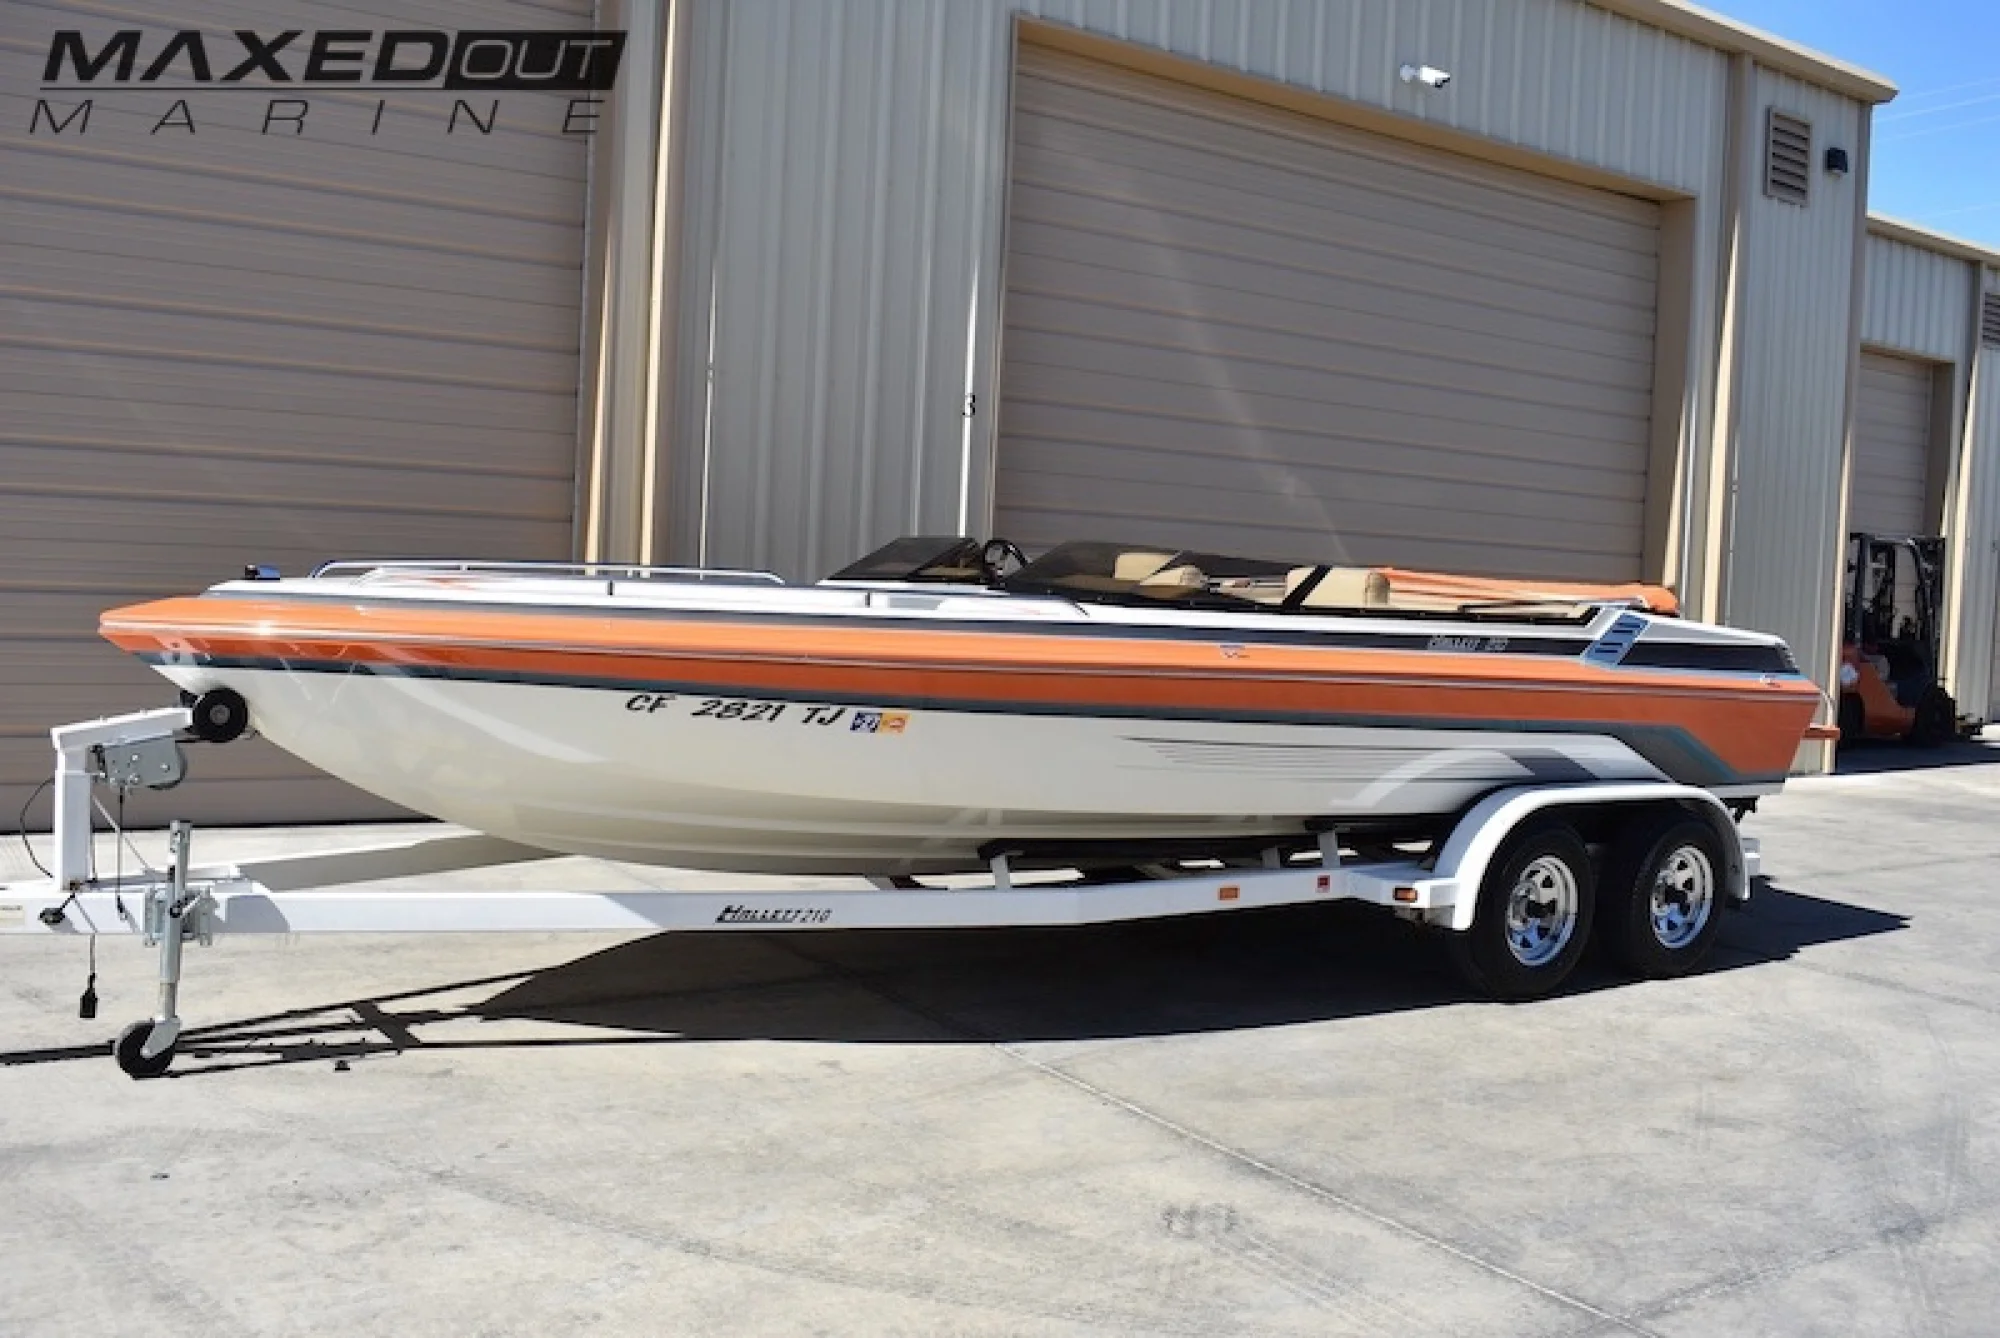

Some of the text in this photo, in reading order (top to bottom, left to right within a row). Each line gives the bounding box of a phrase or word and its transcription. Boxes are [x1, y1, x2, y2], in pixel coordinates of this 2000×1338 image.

[625, 694, 677, 713] CF
[691, 700, 787, 722] 2821
[802, 707, 847, 725] TJ
